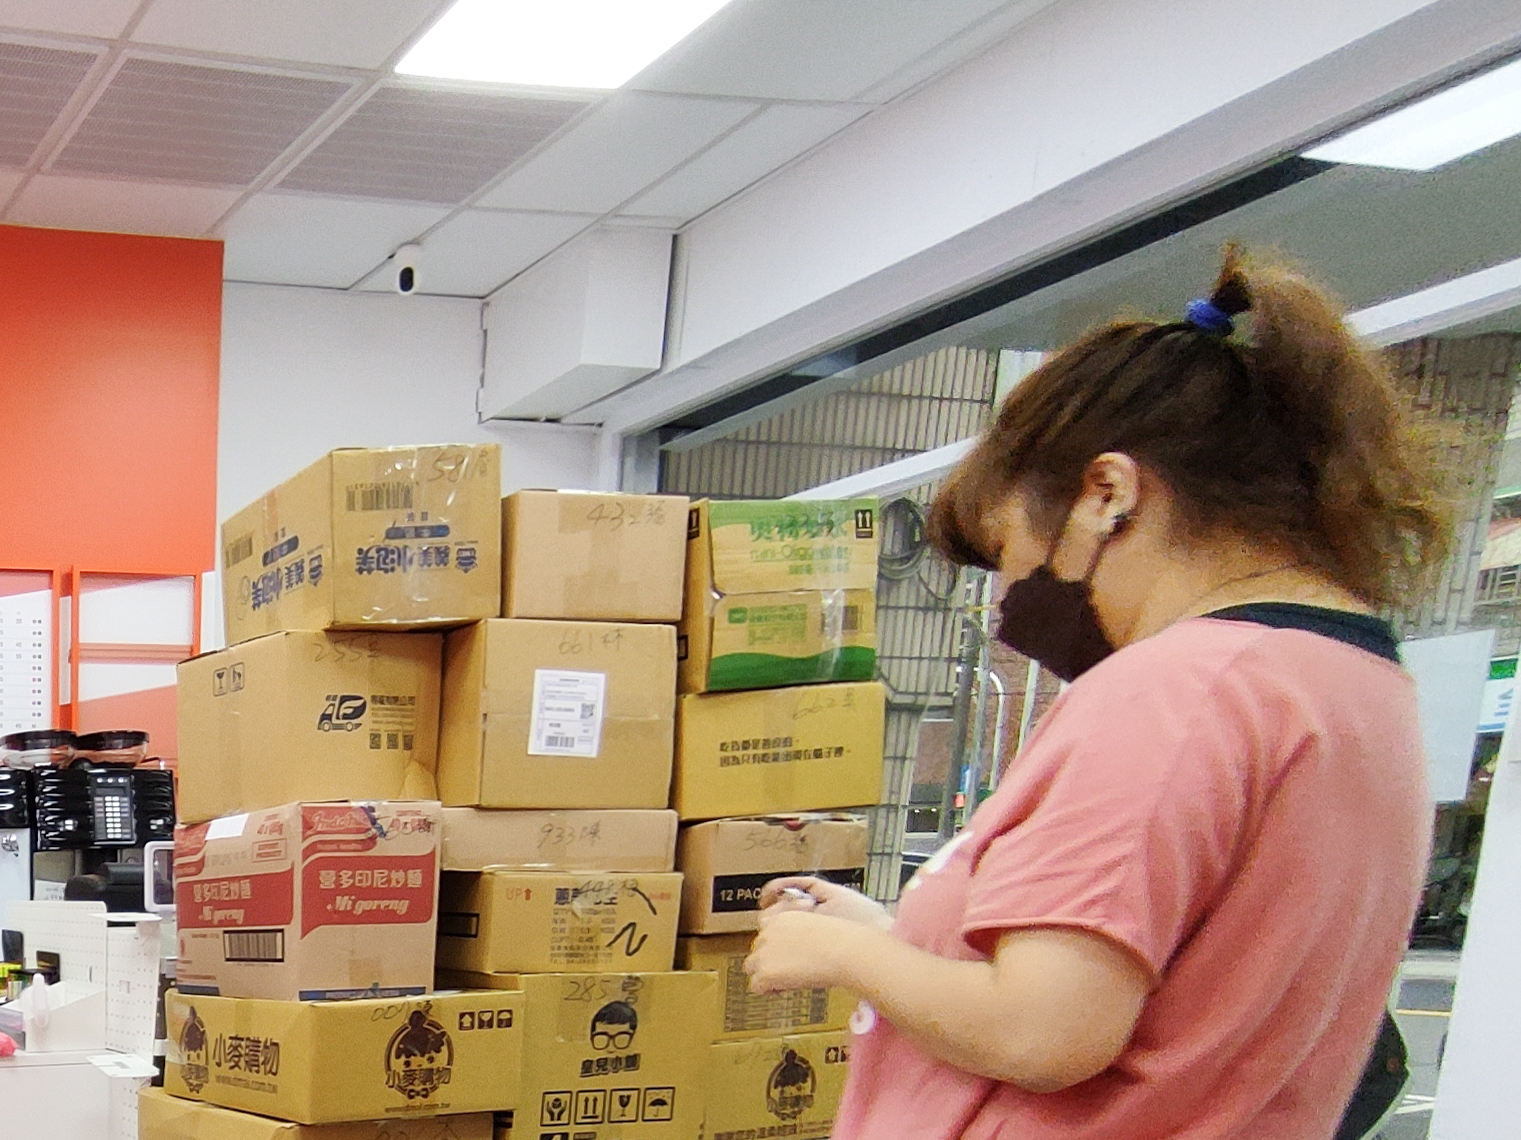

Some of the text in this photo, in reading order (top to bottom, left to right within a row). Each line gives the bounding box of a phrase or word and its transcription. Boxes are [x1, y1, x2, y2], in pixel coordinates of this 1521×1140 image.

[319, 868, 423, 889] 營多印尼炒麵
[720, 887, 762, 901] 12 PAC
[212, 1032, 280, 1077] 小麥購物
[384, 1067, 452, 1089] 小麥購物
